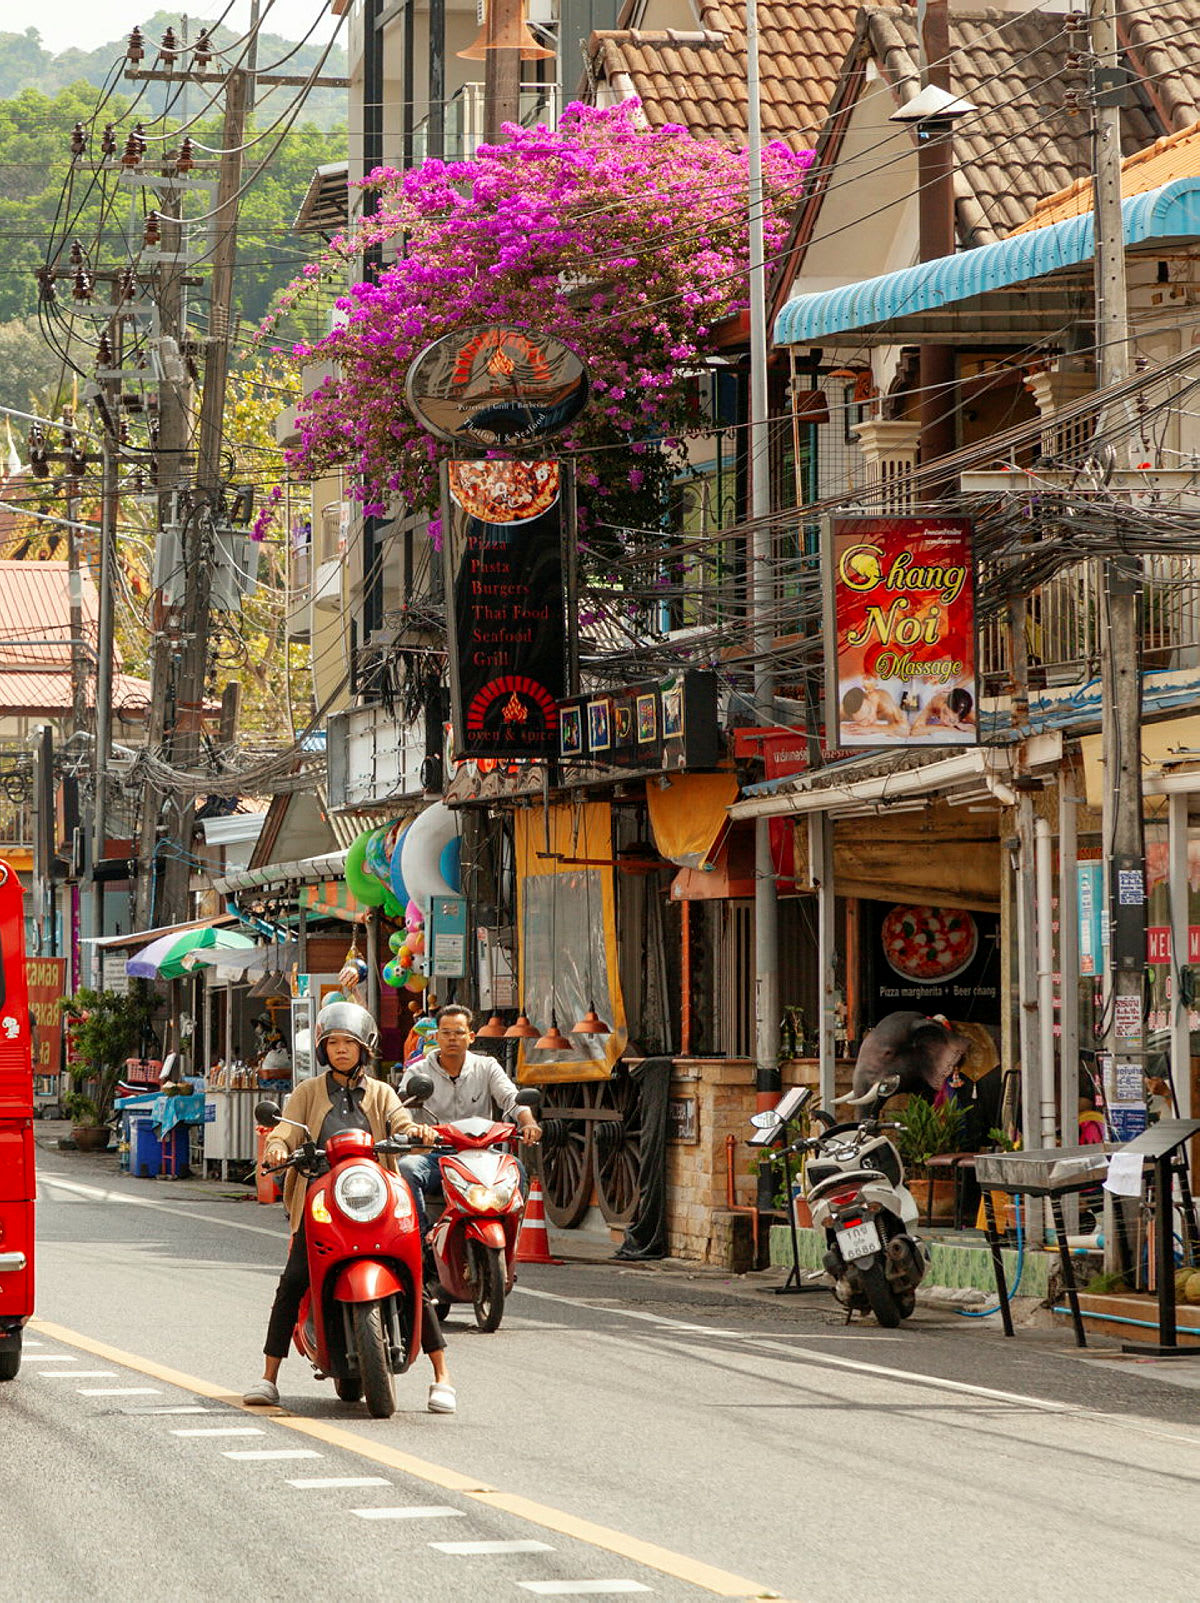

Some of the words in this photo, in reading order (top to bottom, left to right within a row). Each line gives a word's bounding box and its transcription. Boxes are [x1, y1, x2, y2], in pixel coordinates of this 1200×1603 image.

[468, 536, 507, 551] Pizza
[470, 559, 511, 573] Pasta
[472, 580, 532, 597] Burgers
[472, 605, 507, 620] Thai
[512, 604, 550, 620] Food
[847, 597, 940, 647] Noi
[473, 627, 532, 643] Seafood
[473, 650, 511, 667] Grill
[879, 985, 900, 997] Pizza
